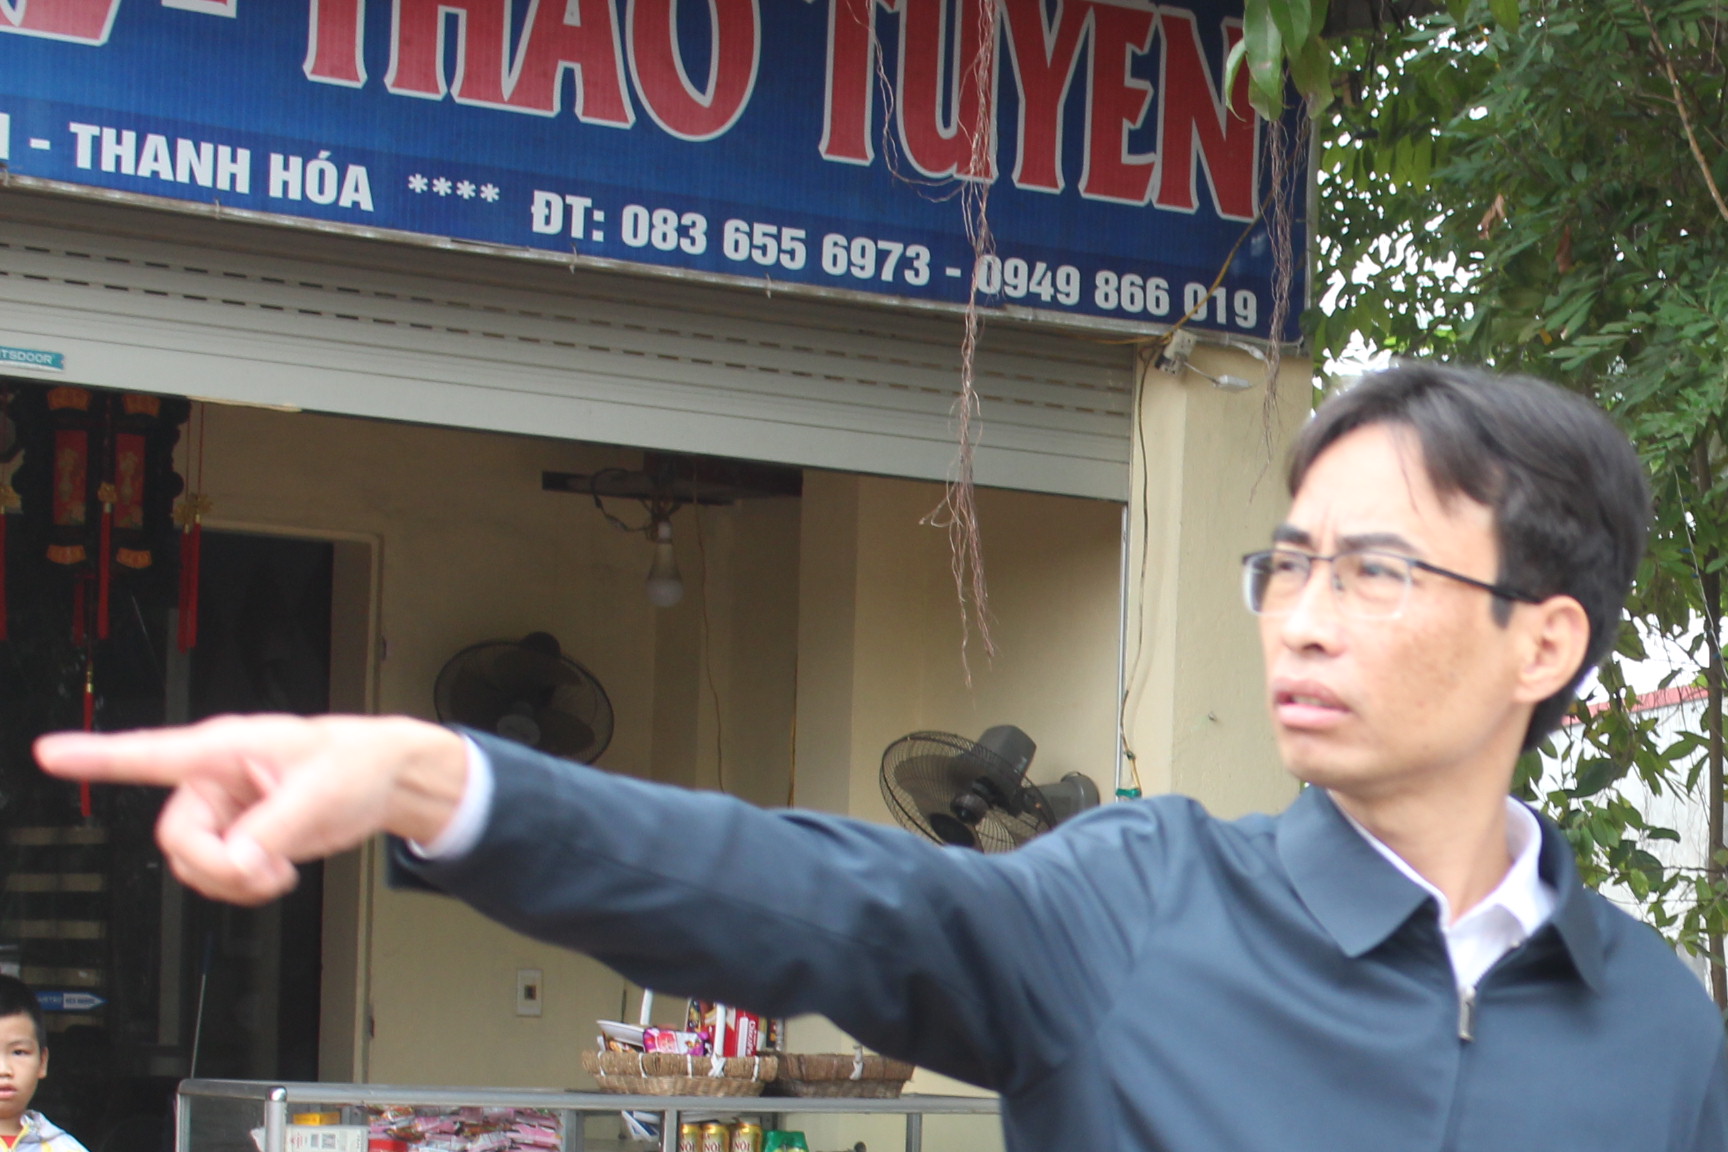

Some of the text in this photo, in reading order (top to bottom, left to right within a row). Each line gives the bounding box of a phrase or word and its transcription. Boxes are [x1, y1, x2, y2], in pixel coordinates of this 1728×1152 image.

[68, 121, 251, 195] THANH
[268, 150, 374, 212] HÓA
[531, 189, 605, 242] ĐT:
[621, 204, 708, 255] 083
[723, 218, 806, 270] 655
[821, 233, 931, 286] 6973
[977, 254, 1081, 306] 0949
[1095, 270, 1170, 316] 866
[1183, 282, 1257, 329] 019
